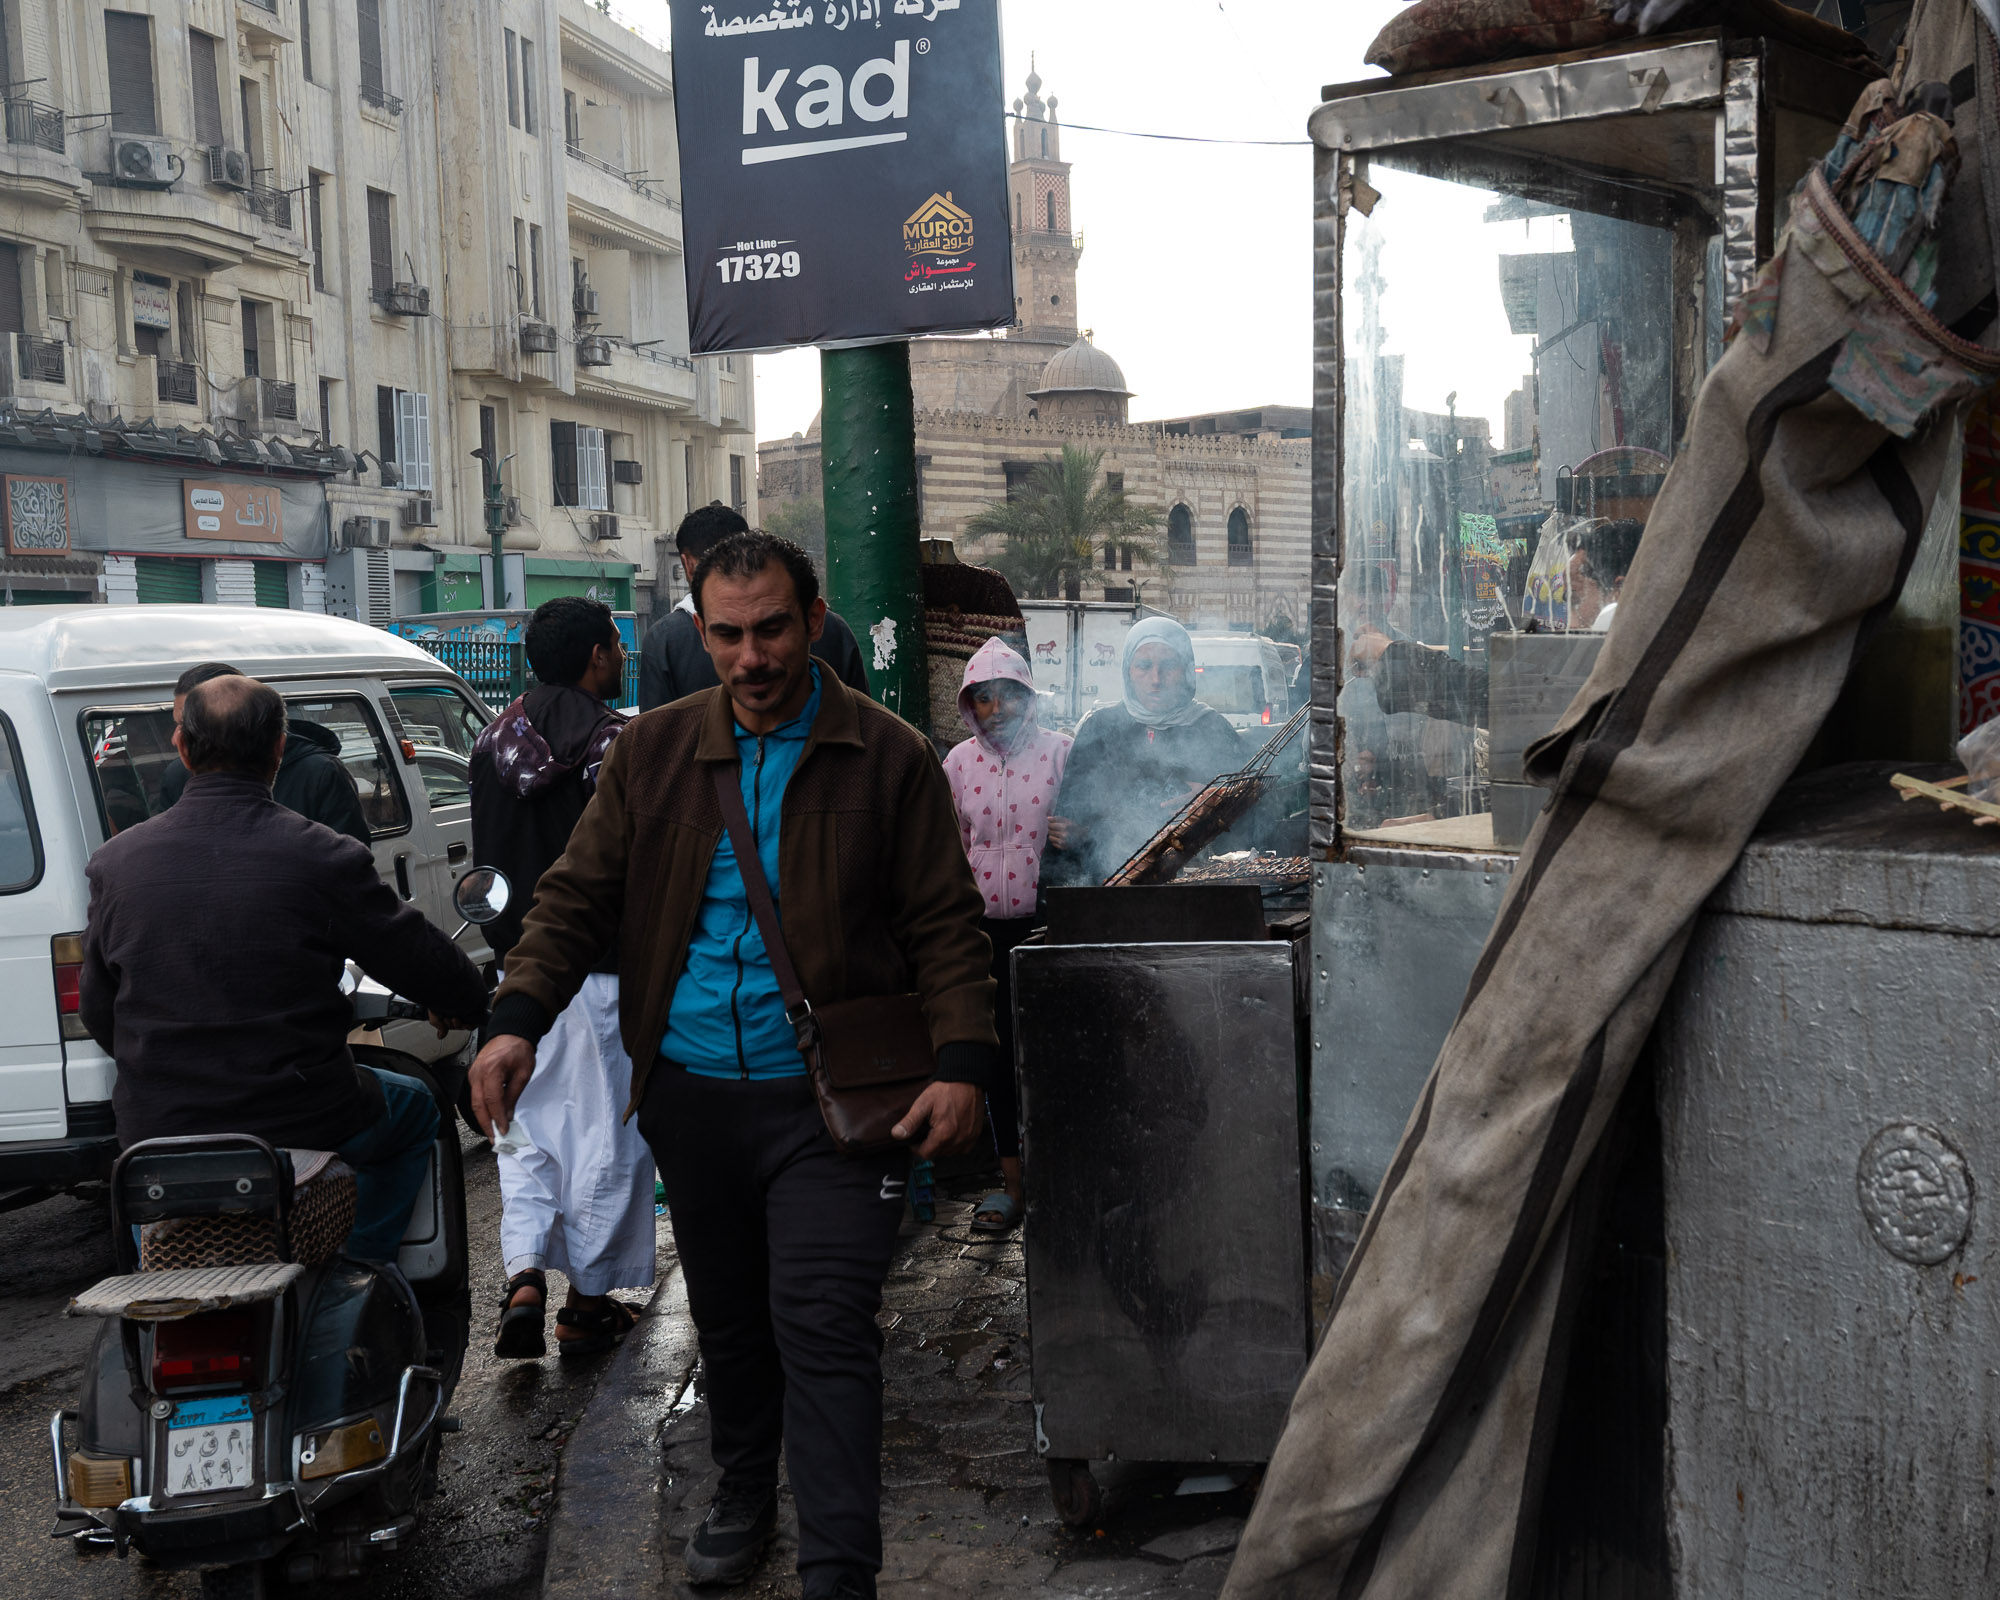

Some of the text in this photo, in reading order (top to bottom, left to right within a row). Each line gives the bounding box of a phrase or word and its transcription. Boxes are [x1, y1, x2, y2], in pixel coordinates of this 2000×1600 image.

[742, 39, 910, 135] kad
[902, 218, 974, 240] MUROJ
[736, 239, 777, 252] Hot Line
[904, 235, 974, 253] مروج العقارية
[716, 250, 801, 283] 17329
[935, 257, 960, 267] مجموعة
[235, 493, 278, 535] رائف
[173, 1412, 206, 1426] EGYPT
